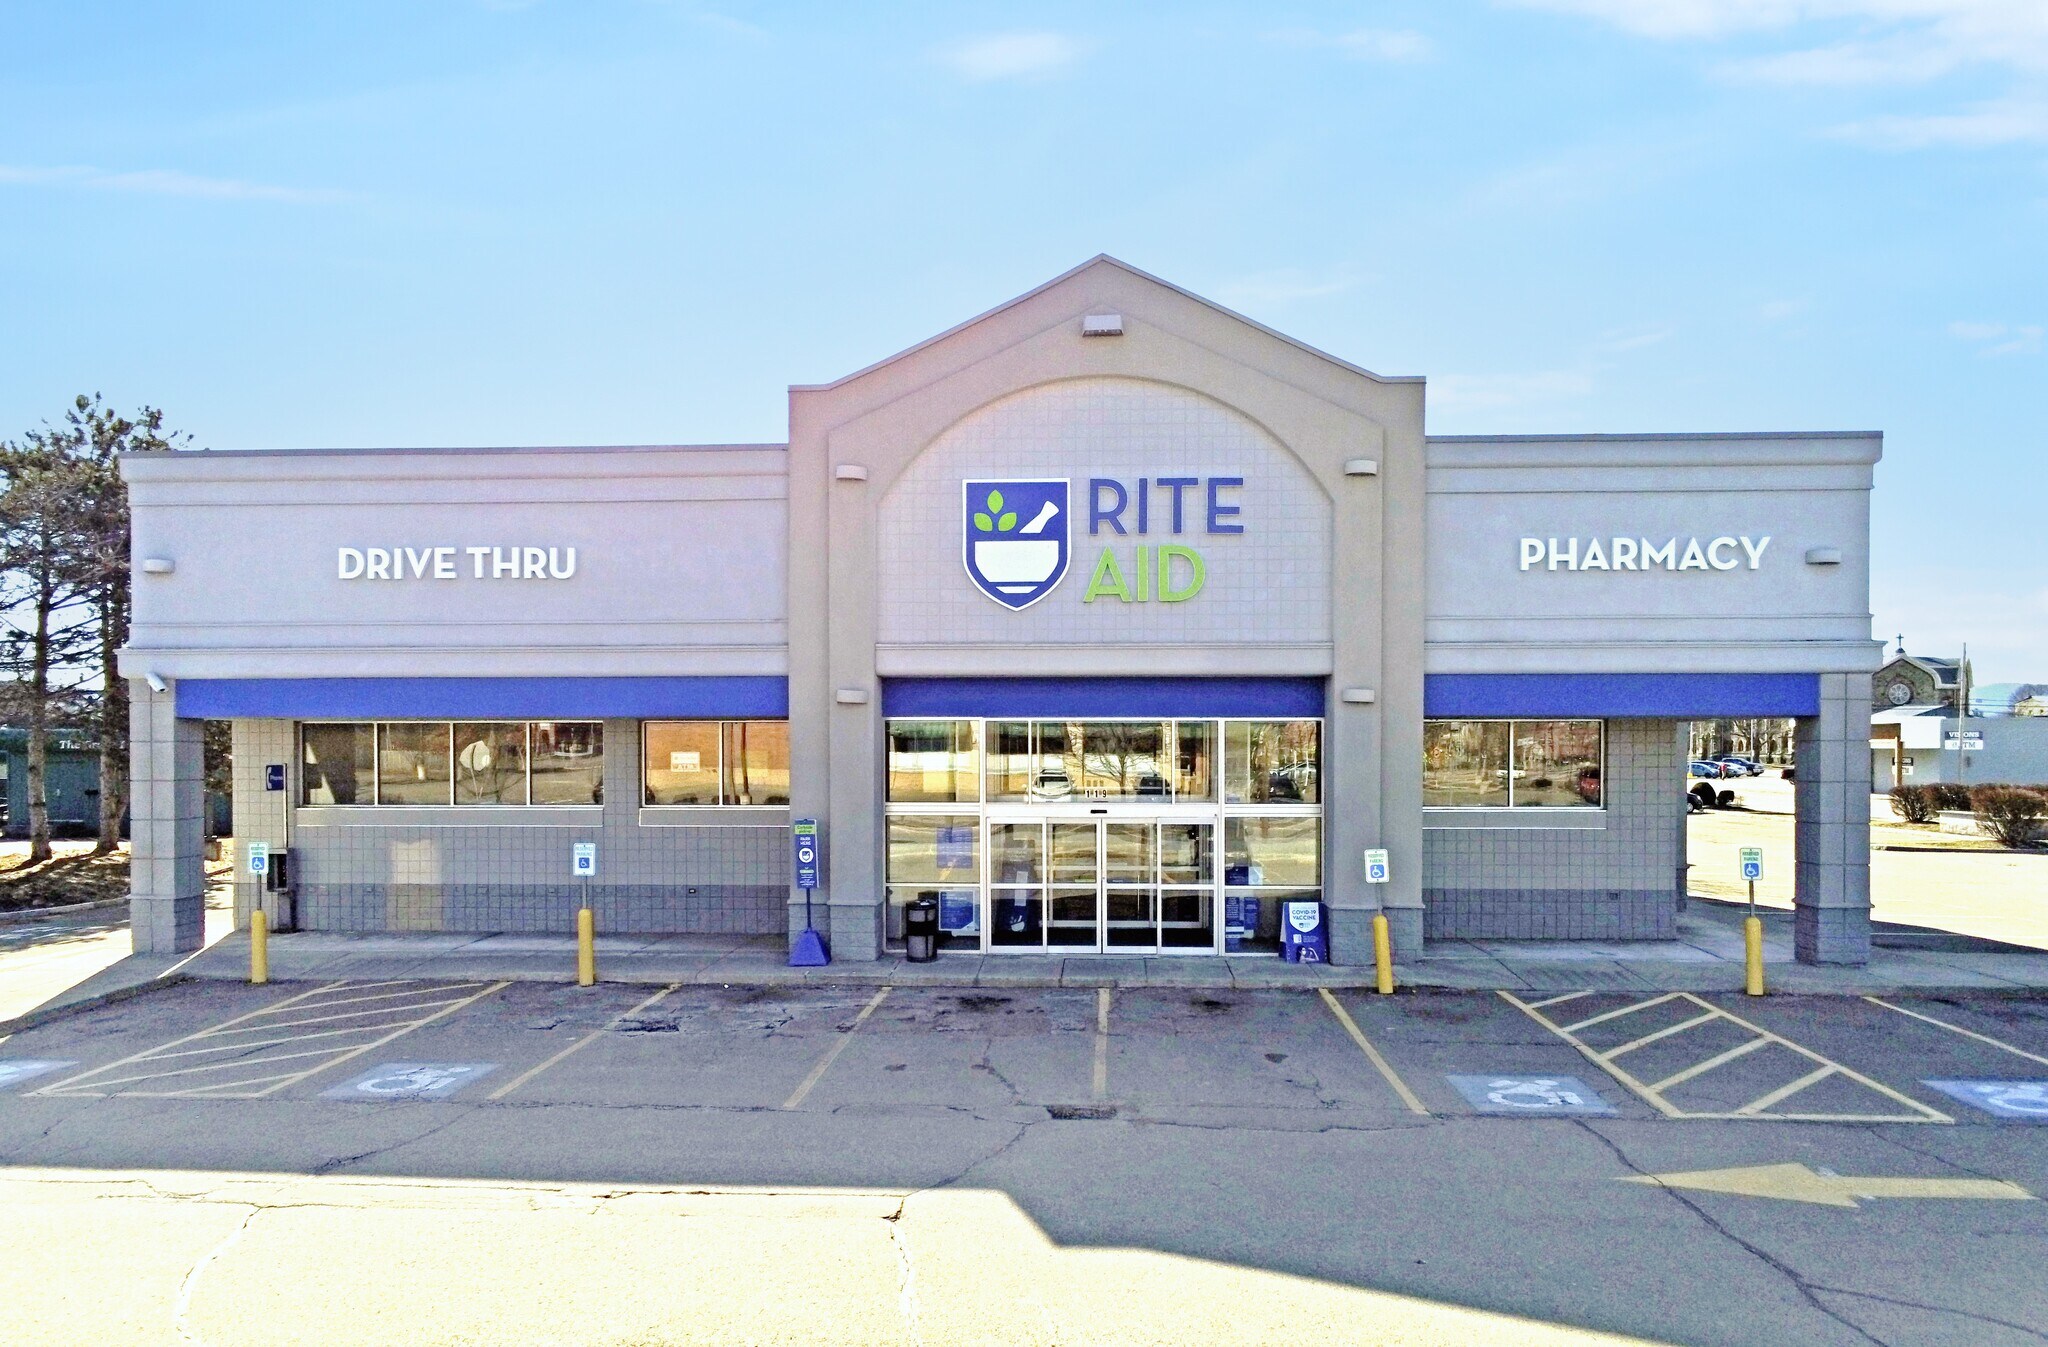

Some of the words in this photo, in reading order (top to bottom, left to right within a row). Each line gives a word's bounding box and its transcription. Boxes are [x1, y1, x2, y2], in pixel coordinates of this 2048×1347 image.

[1089, 477, 1245, 535] RITE
[338, 547, 456, 579] DRIVE
[466, 547, 577, 579] THRU
[1083, 545, 1206, 603] AID
[1520, 536, 1771, 571] PHARMACY
